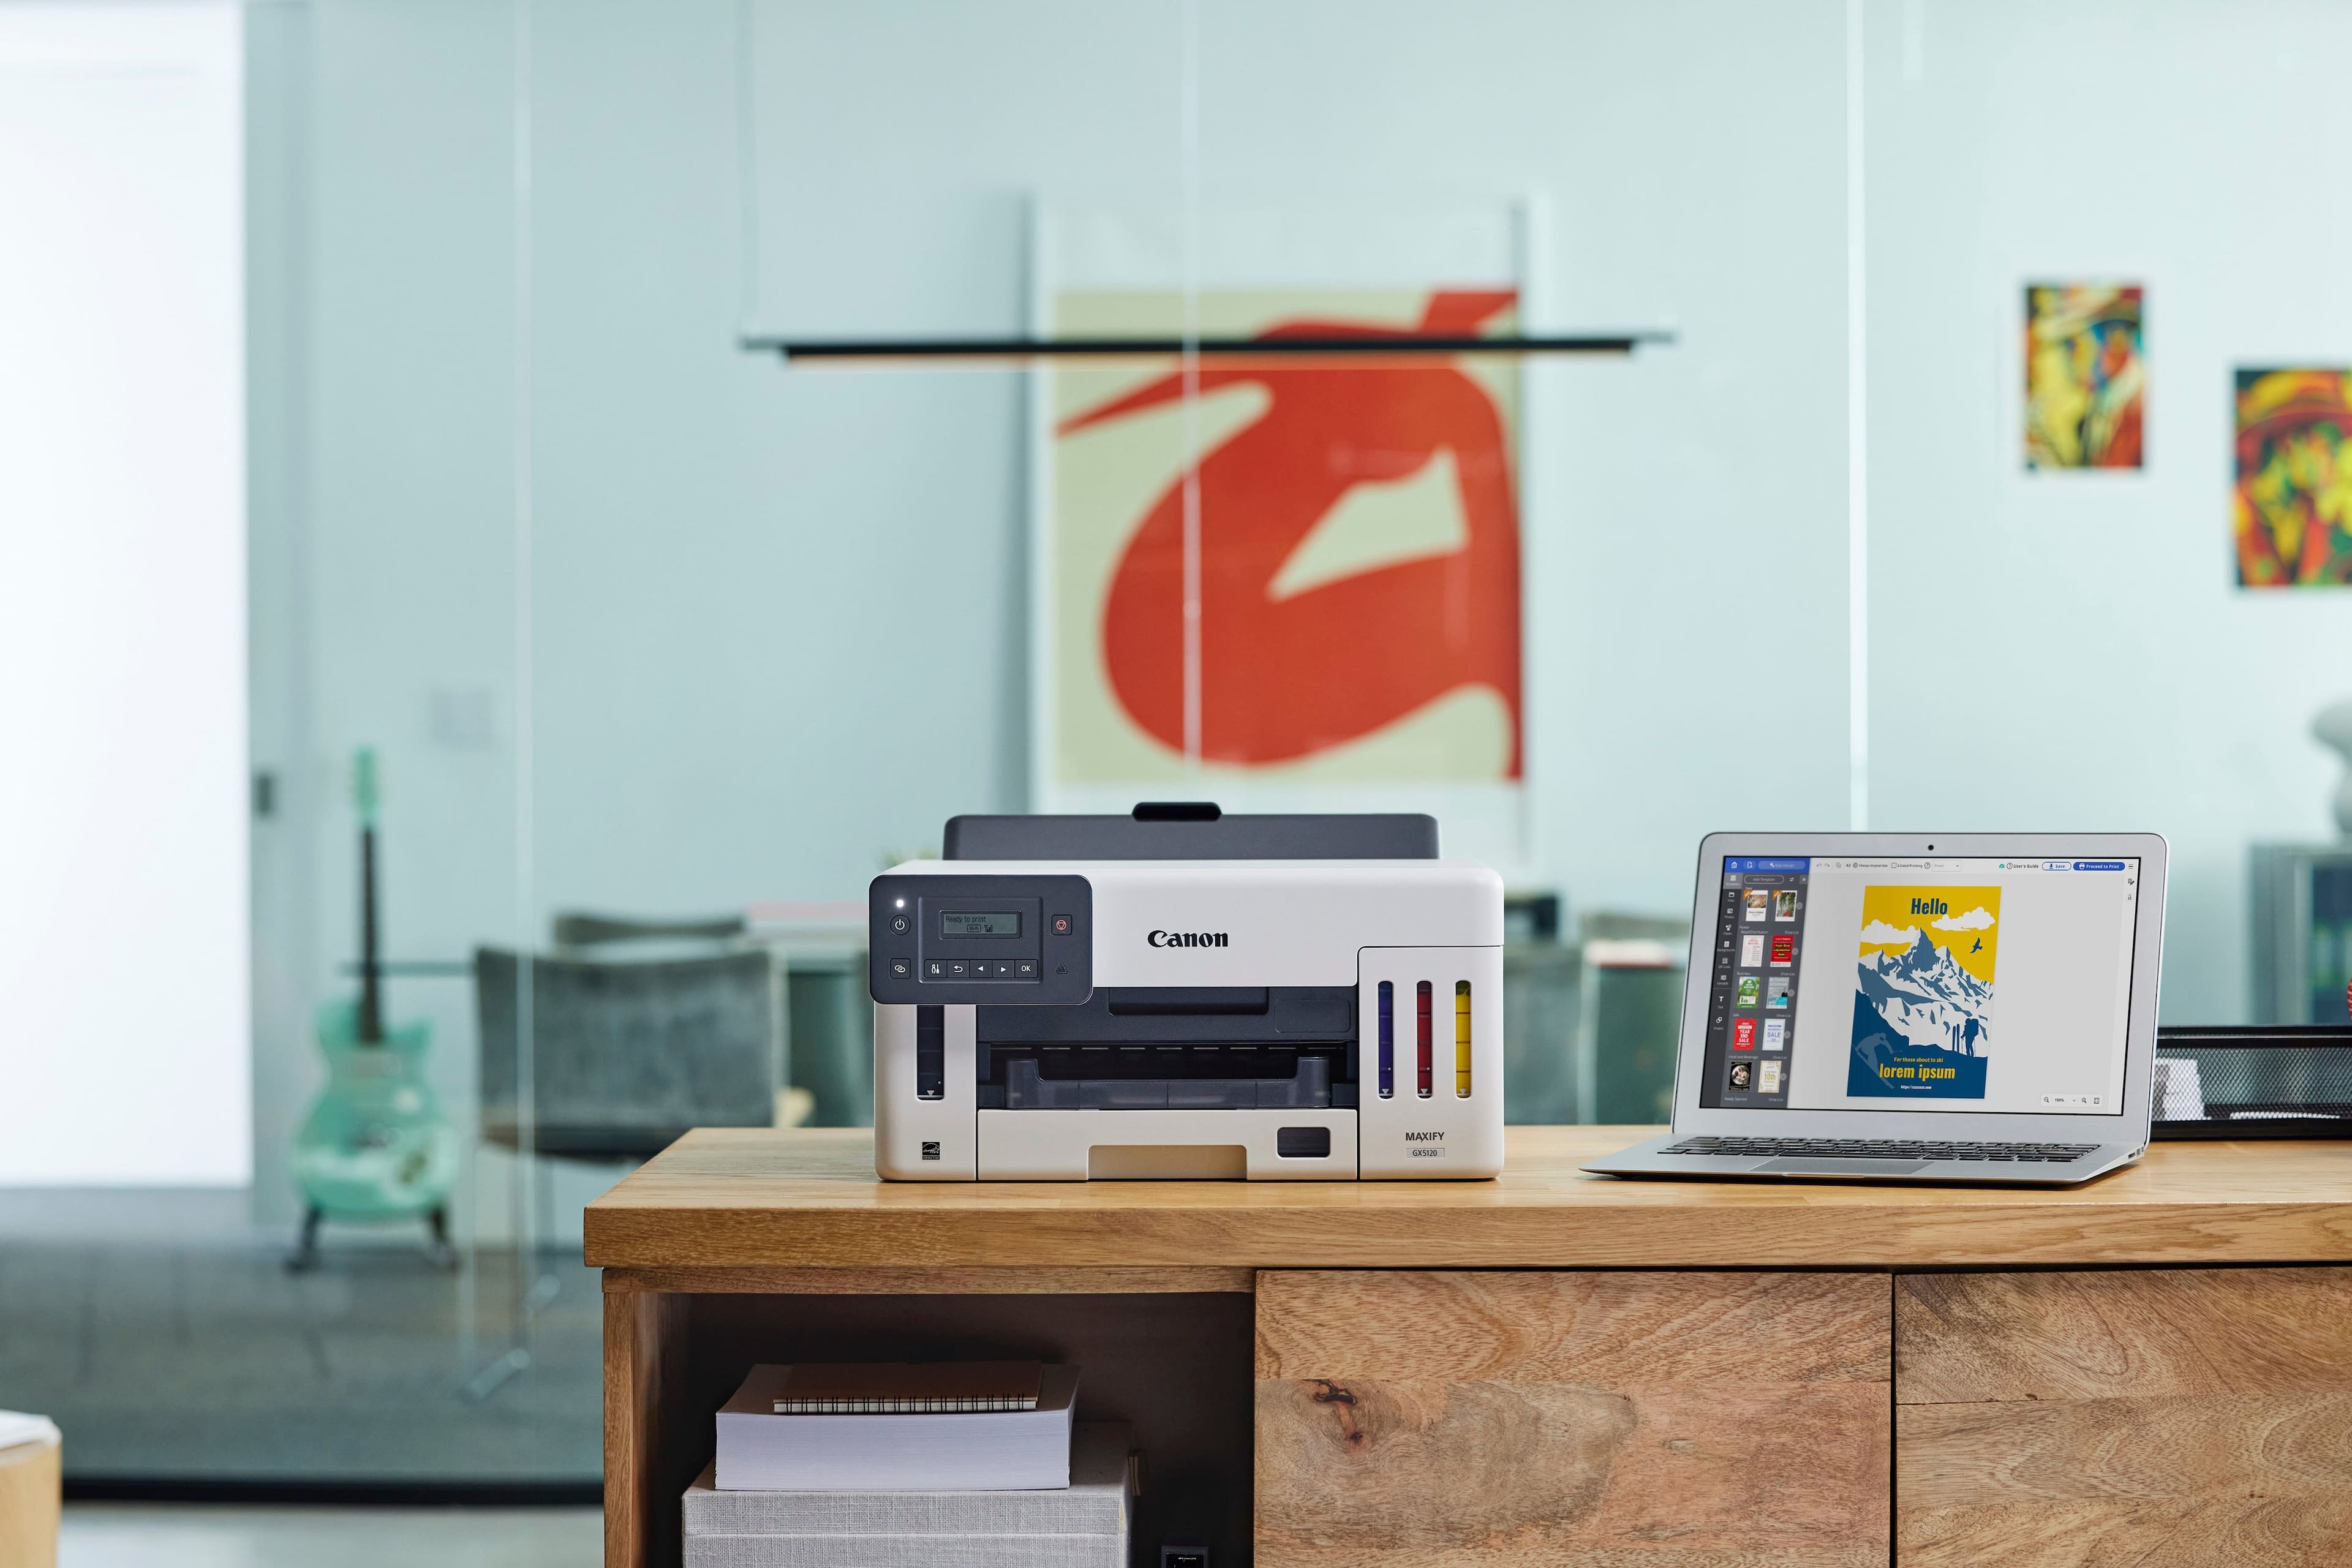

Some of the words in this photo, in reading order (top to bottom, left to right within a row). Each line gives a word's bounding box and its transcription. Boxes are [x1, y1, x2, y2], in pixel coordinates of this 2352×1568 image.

[1911, 898, 1948, 914] Hello
[945, 916, 962, 924] Ready
[972, 916, 986, 924] print
[1147, 930, 1228, 948] Canon
[1879, 1063, 1915, 1079] lorem
[1918, 1065, 1956, 1082] ipsum
[1406, 1132, 1445, 1143] MAXIFY
